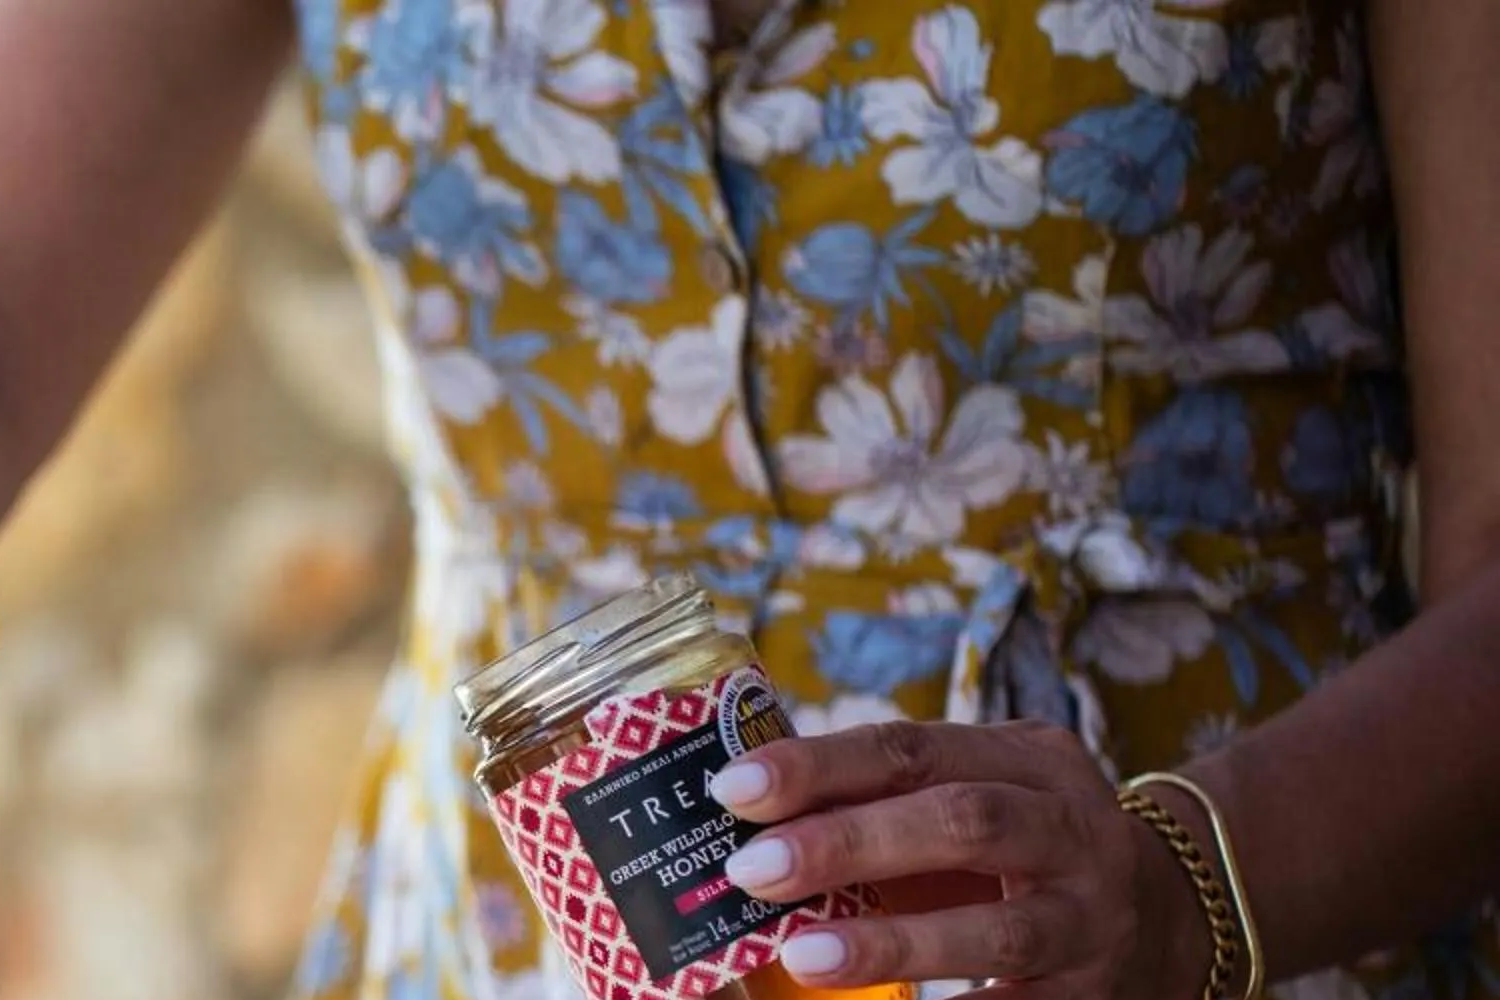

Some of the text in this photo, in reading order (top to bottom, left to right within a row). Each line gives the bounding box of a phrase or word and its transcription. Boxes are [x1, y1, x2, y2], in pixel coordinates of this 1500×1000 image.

[610, 812, 742, 885] GREEK WILDFLO
[656, 831, 738, 887] HONEY
[695, 877, 730, 902] SILK
